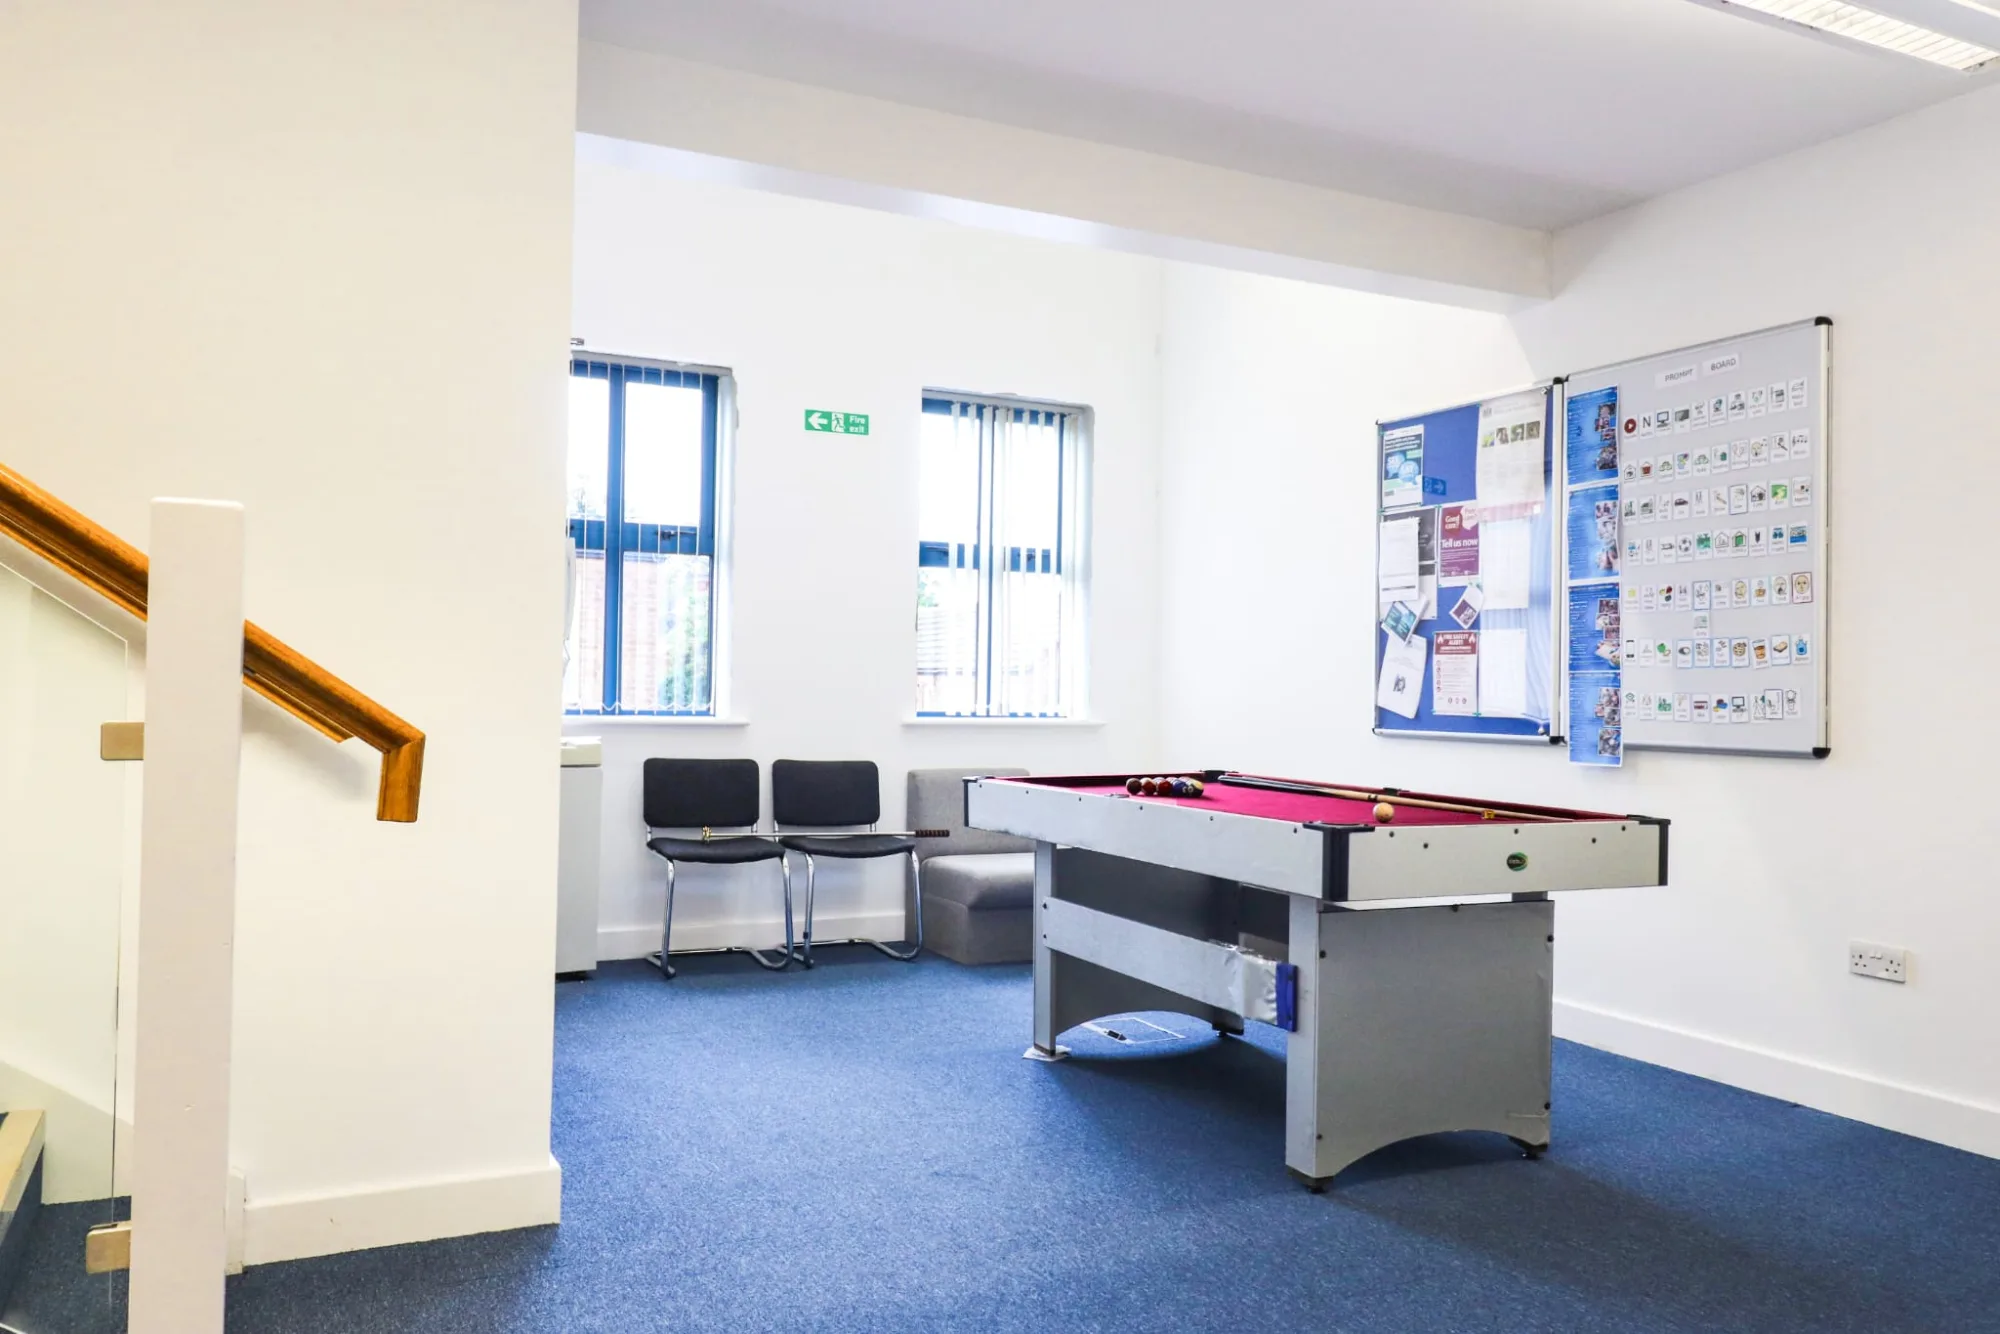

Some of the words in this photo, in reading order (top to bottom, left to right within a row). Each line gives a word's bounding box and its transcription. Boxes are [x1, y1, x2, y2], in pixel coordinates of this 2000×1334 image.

[1664, 368, 1693, 382] PROMPT
[1710, 358, 1736, 371] BOARD
[849, 415, 866, 424] Fire
[849, 425, 865, 433] exit
[1441, 539, 1453, 549] Tell
[1462, 539, 1478, 547] now
